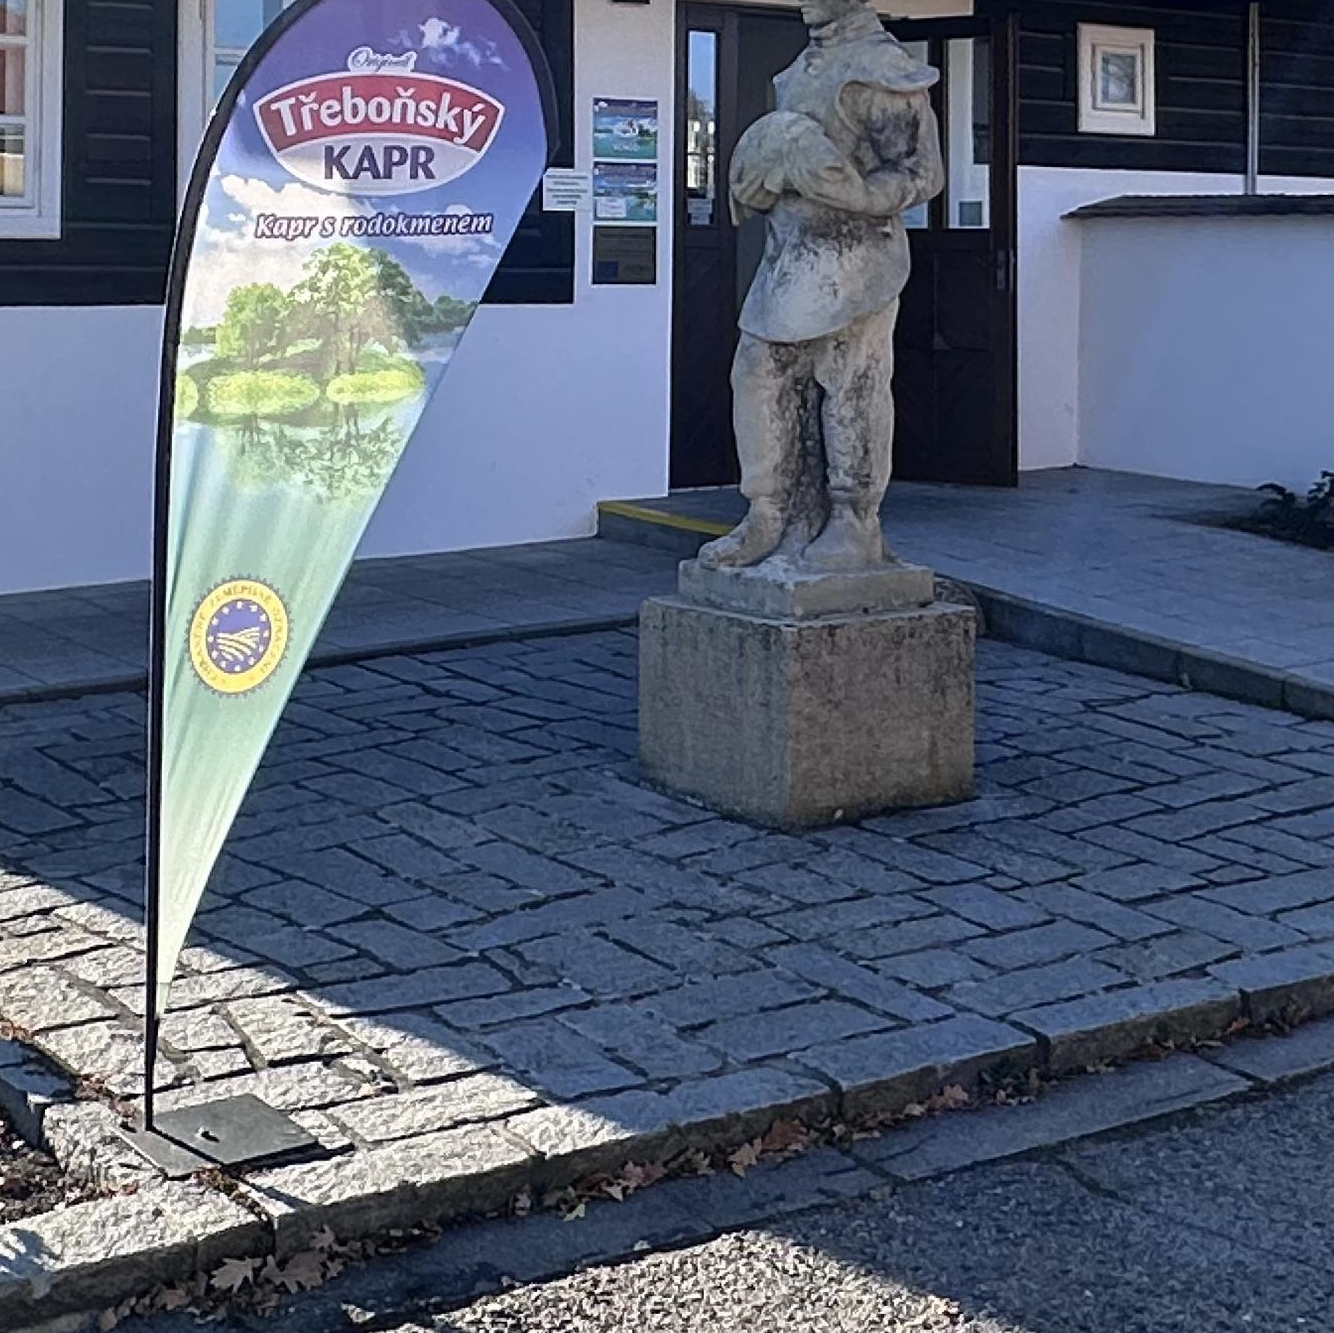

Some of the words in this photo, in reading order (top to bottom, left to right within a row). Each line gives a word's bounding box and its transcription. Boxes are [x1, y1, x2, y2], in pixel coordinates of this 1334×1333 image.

[271, 86, 486, 144] Třeboňský
[324, 145, 436, 180] KAPR
[255, 213, 316, 240] Kapr
[318, 217, 336, 239] s
[338, 212, 494, 239] rodokmenem
